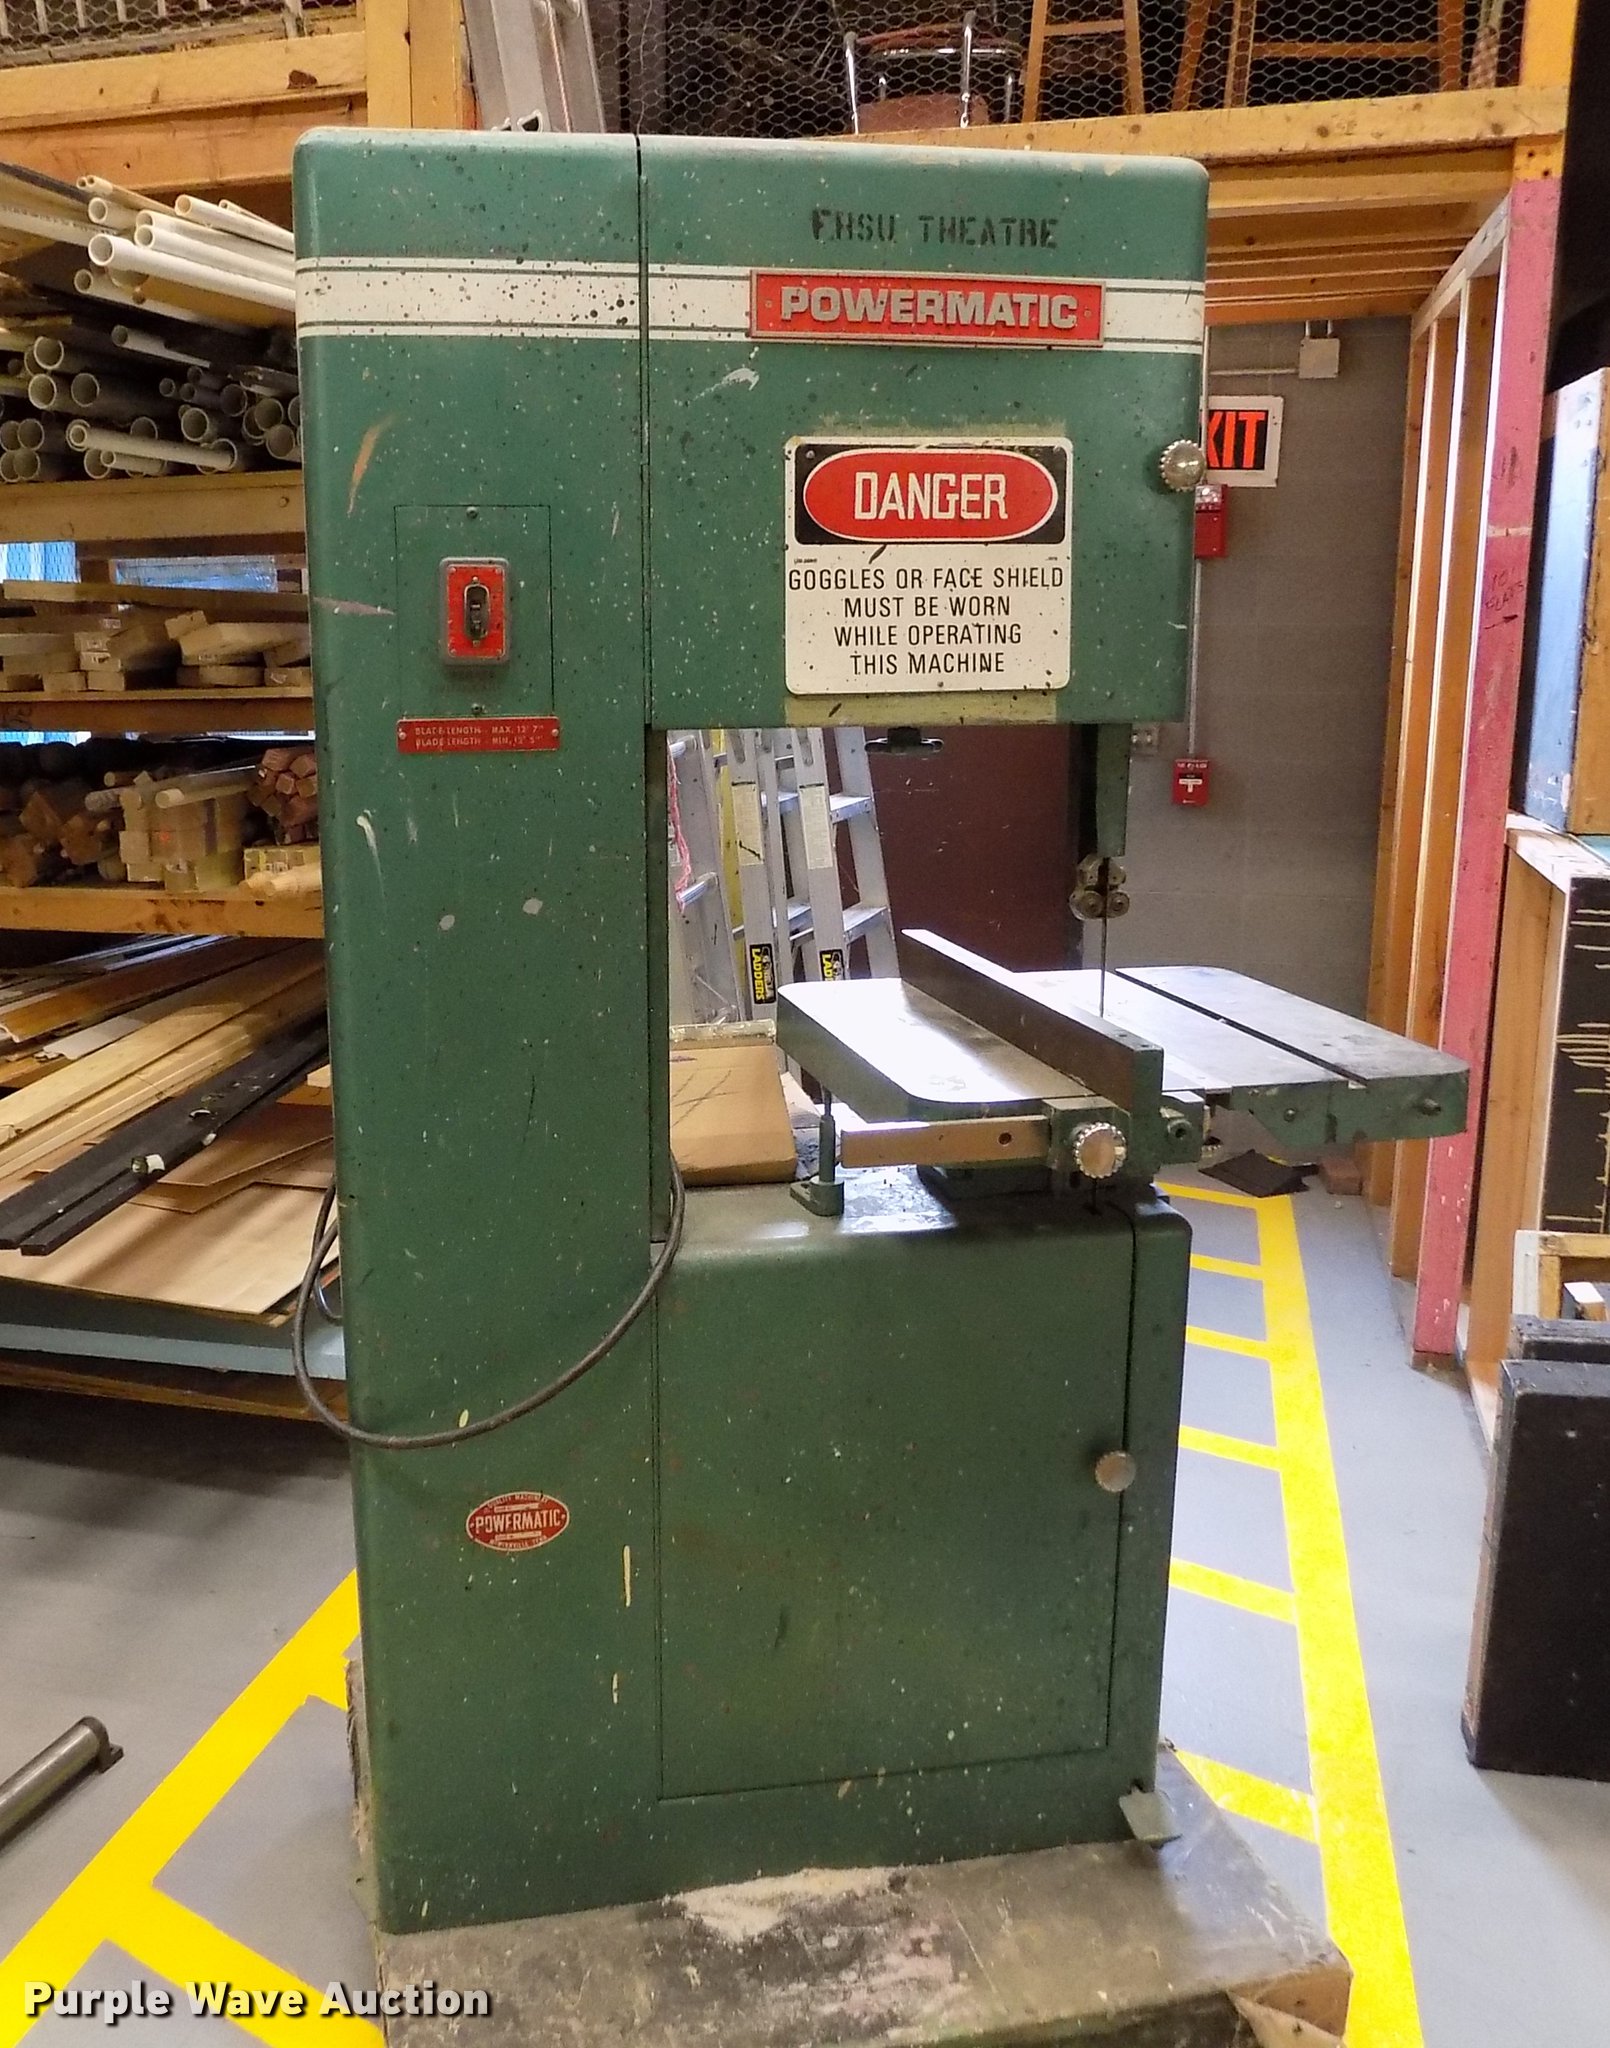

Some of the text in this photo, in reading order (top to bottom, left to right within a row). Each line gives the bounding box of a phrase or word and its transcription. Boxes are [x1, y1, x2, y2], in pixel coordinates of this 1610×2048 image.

[918, 215, 1059, 249] THEATRE
[780, 285, 1079, 330] POWERMATIC
[1207, 411, 1266, 468] XIT
[854, 471, 1008, 520] DANGER
[788, 567, 1064, 590] GOGGLES OR FACE SHIELD
[844, 596, 1011, 618] MUST BE WORN
[834, 623, 1022, 647] WHILE OPERATING
[850, 652, 1005, 675] THIS MACHINE
[446, 726, 482, 735] LENGTH
[447, 737, 481, 746] LENGTH
[751, 948, 765, 1001] LADDERS
[475, 1508, 561, 1534] POWERMATIC
